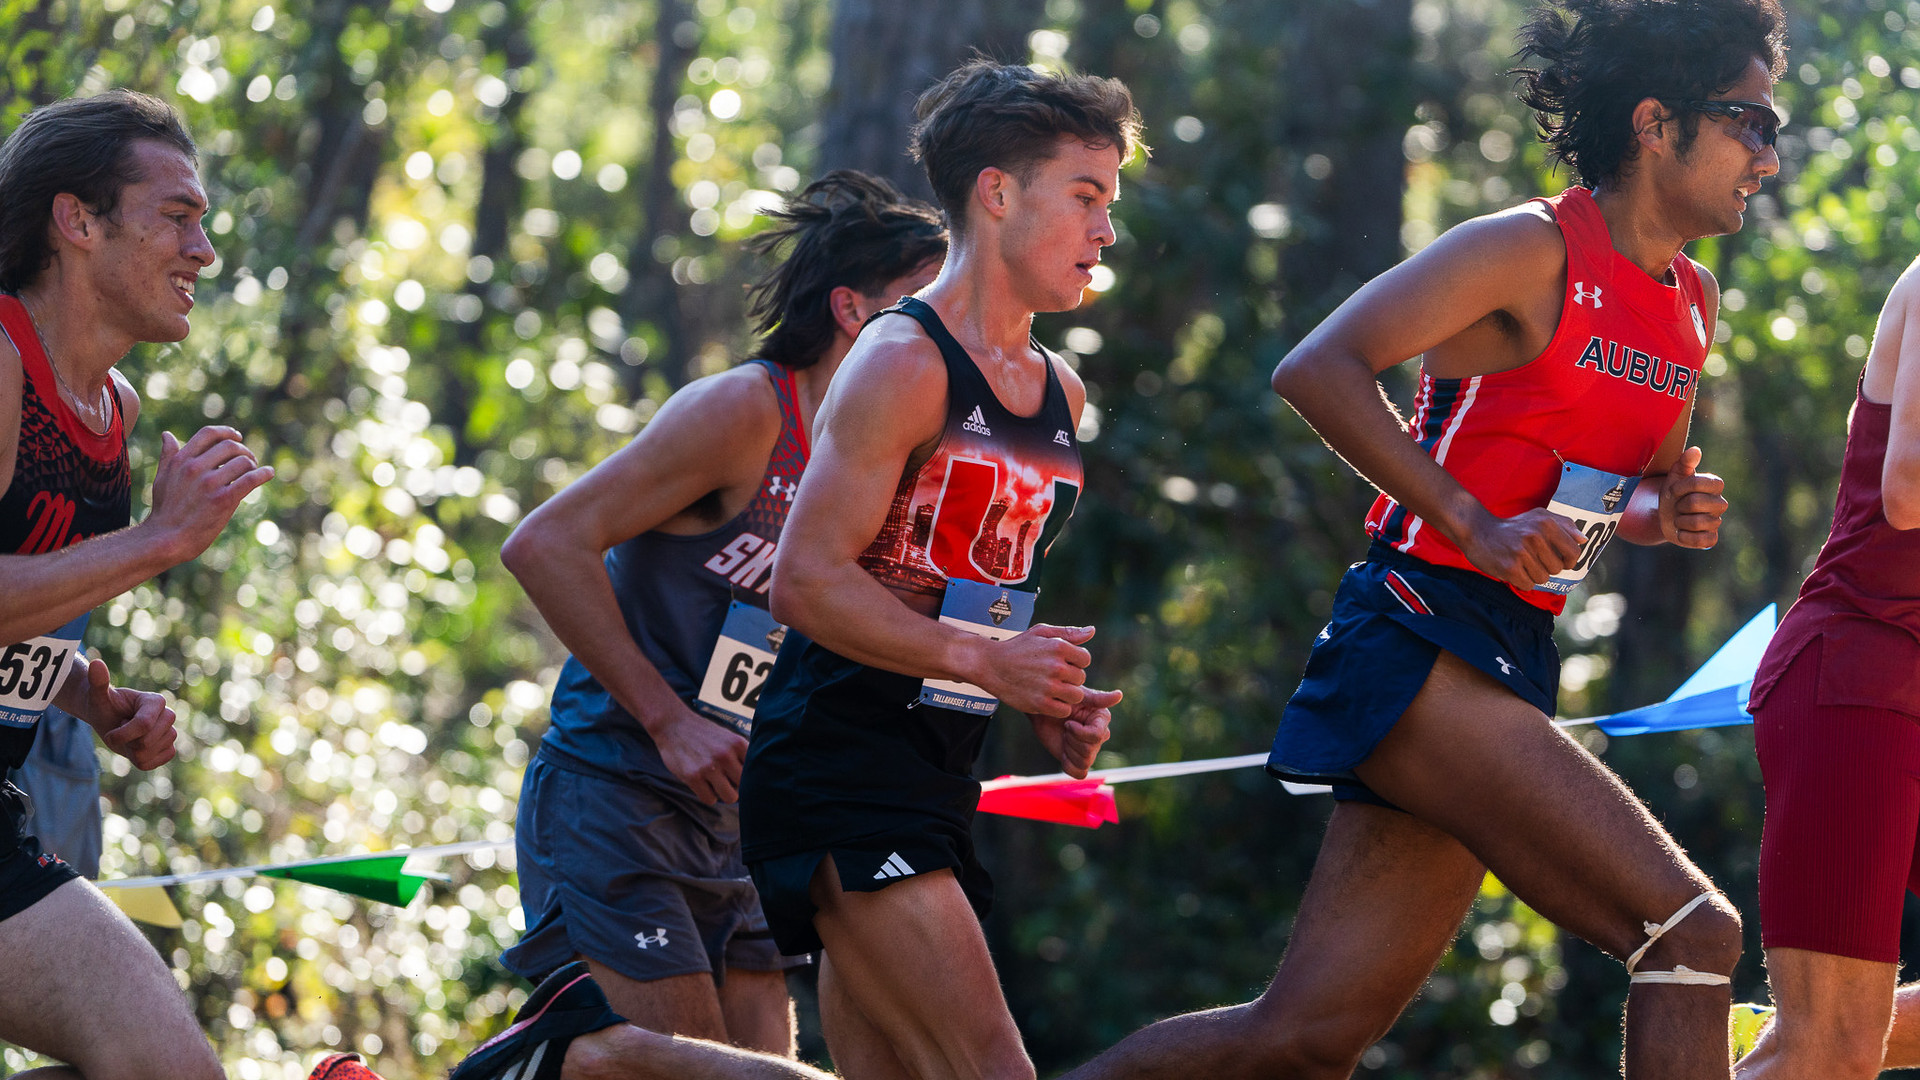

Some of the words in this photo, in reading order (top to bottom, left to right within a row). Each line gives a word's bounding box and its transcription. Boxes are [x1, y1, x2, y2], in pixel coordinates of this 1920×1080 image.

[962, 421, 991, 437] adidas
[1054, 429, 1070, 445] ACC
[0, 643, 69, 701] 531
